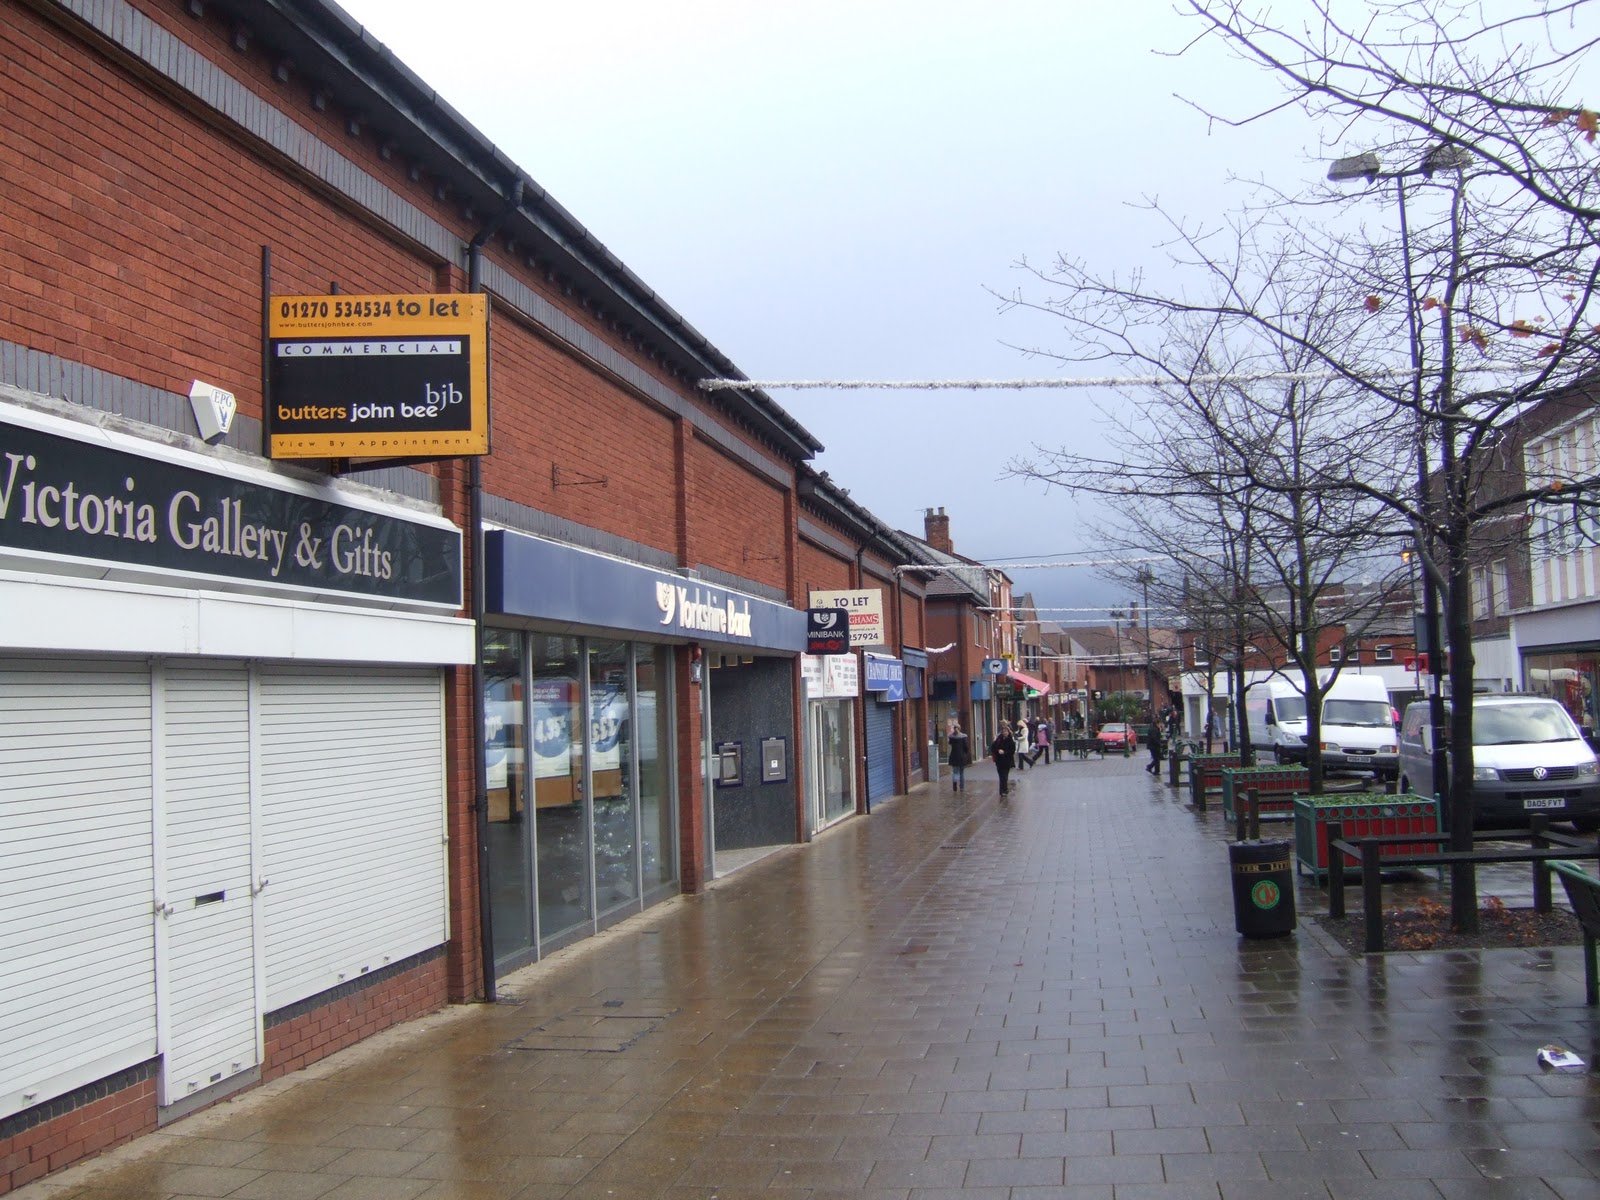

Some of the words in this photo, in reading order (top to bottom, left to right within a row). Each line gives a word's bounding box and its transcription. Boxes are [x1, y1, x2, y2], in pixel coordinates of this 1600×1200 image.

[281, 301, 328, 318] 01270
[334, 301, 391, 317] 534534
[396, 298, 421, 316] to
[429, 298, 459, 316] let
[284, 343, 455, 354] COMMERCIAL
[425, 382, 464, 411] bjb
[277, 404, 347, 420] butters
[350, 403, 395, 422] john
[400, 402, 438, 418] bee
[329, 440, 346, 448] By
[358, 438, 470, 447] Appointment
[0, 452, 157, 543] Victoria
[168, 490, 288, 577] Gallery
[296, 522, 322, 569] &
[331, 524, 392, 580] Gifts
[833, 597, 849, 607] TO
[852, 597, 869, 606] LET
[676, 585, 727, 634] Yorkshire
[727, 599, 752, 638] Bank
[848, 614, 879, 625] GHAMS
